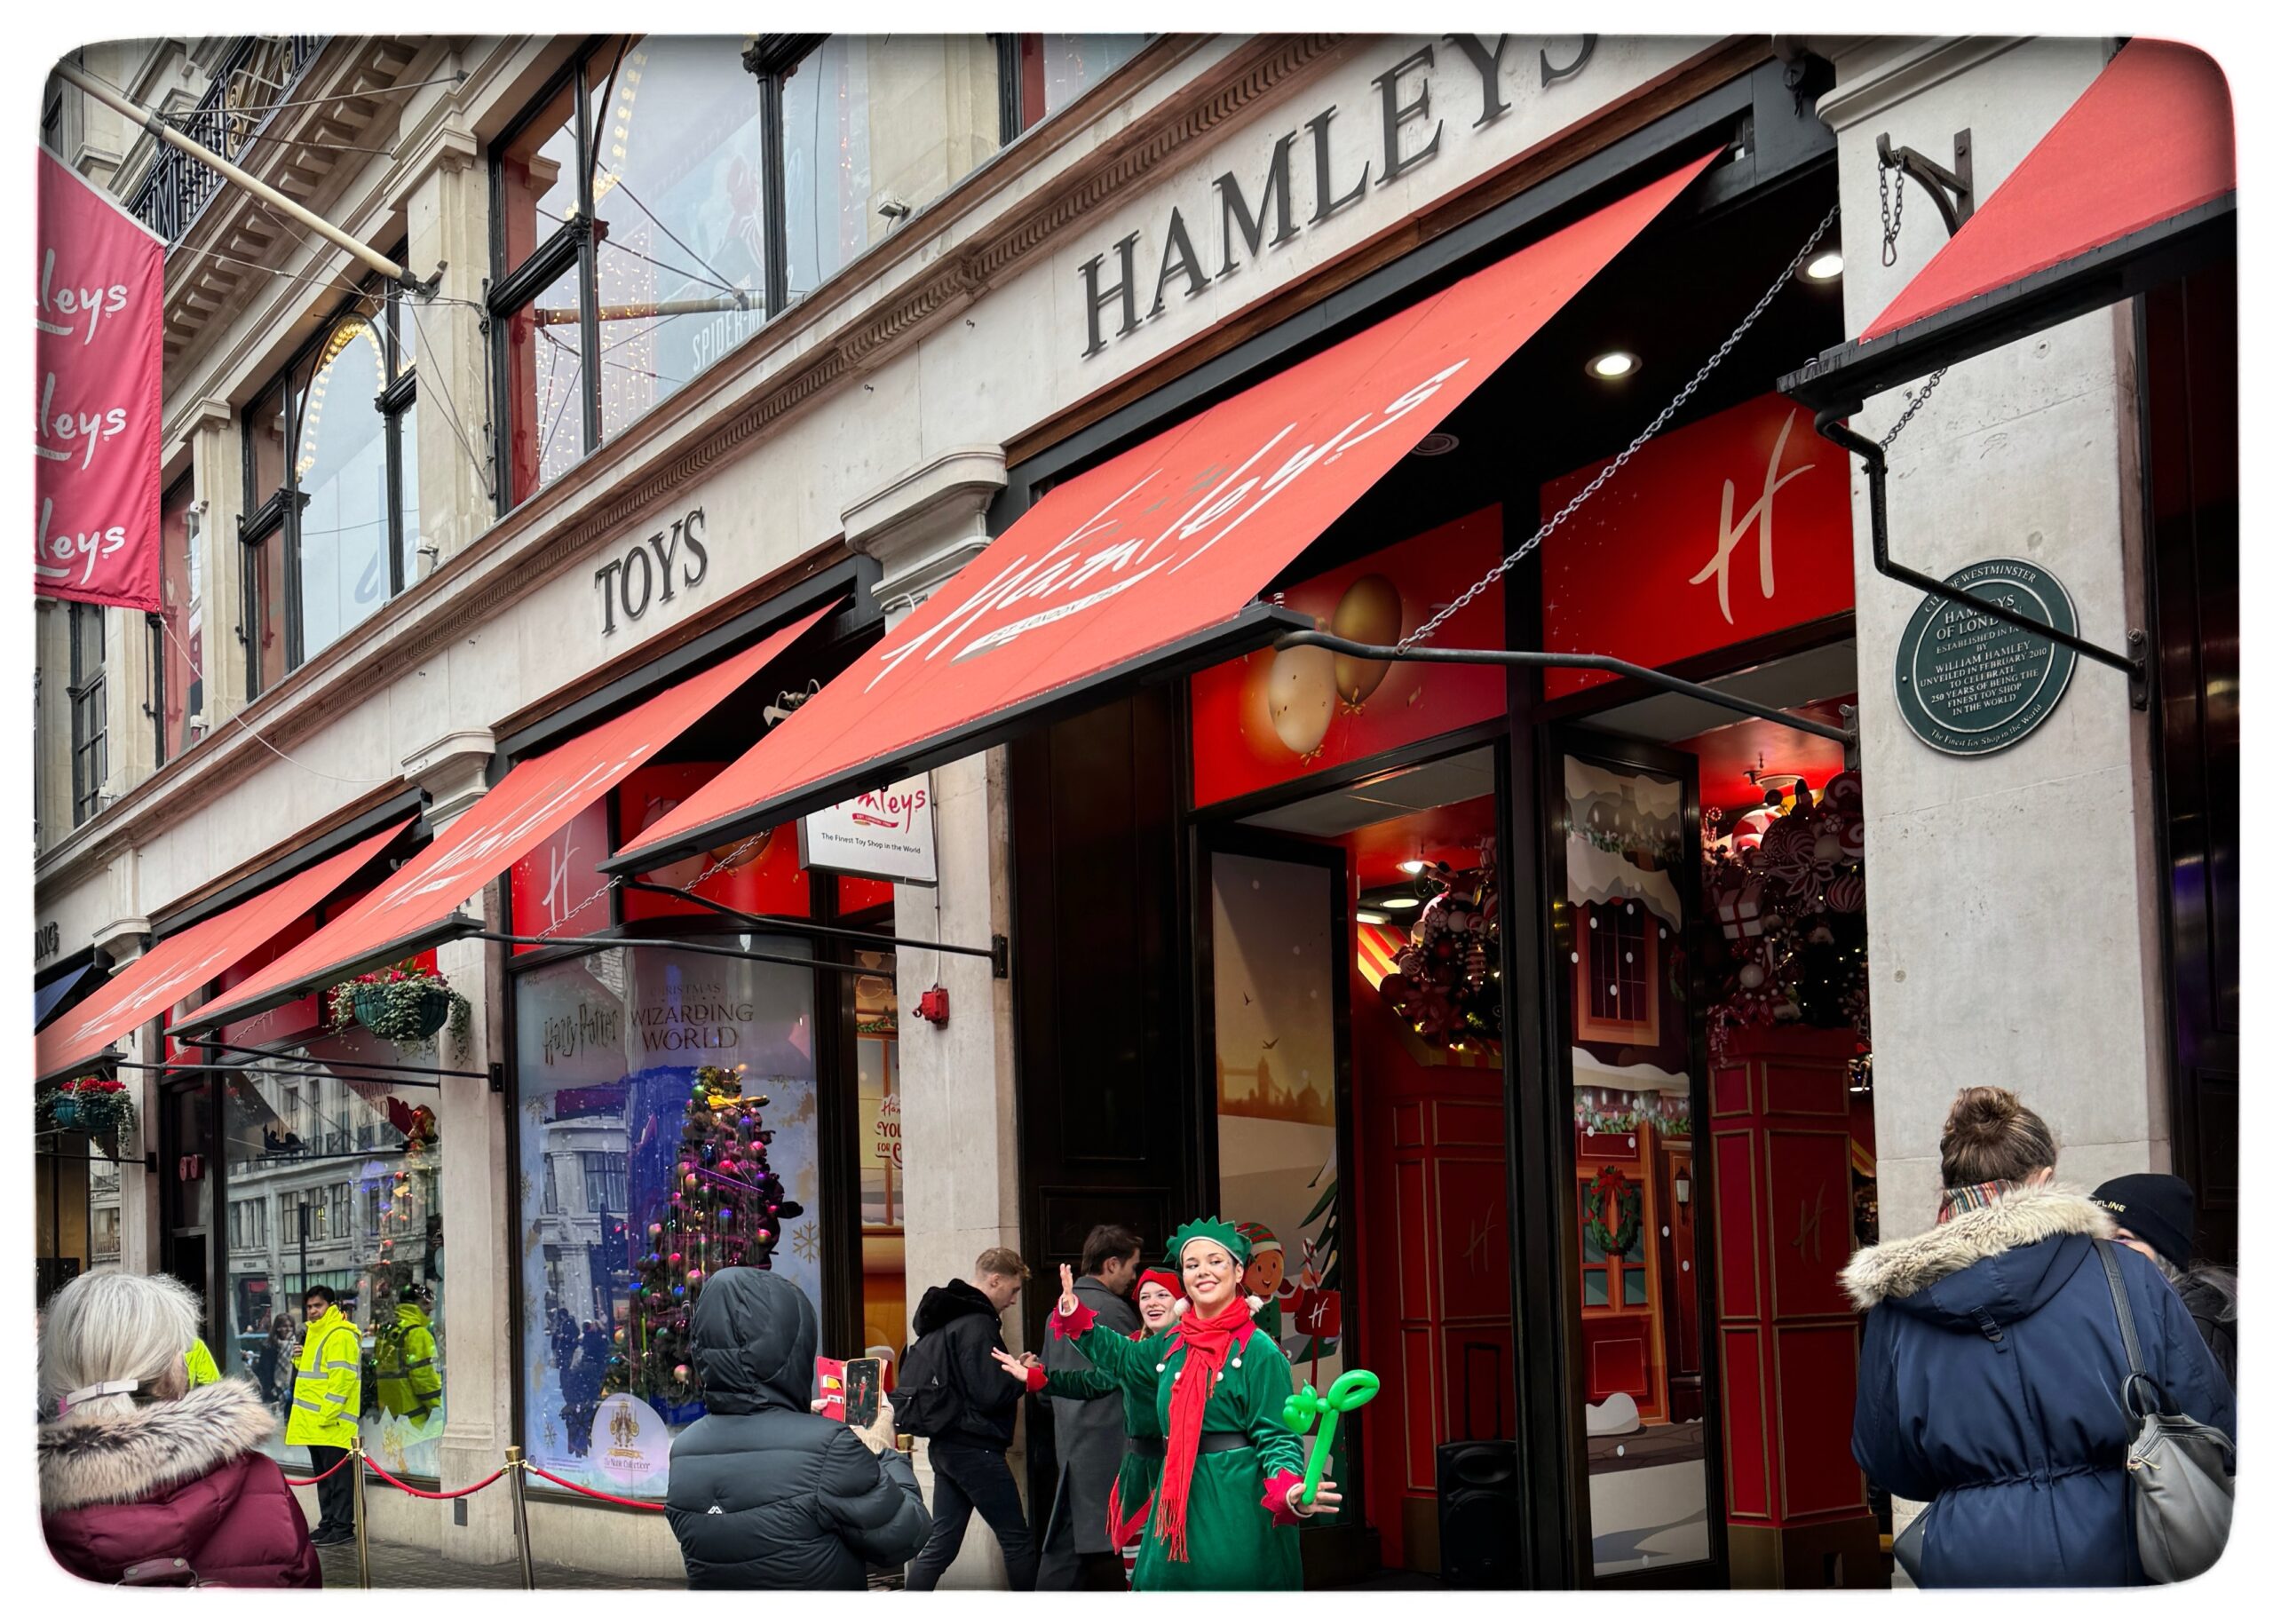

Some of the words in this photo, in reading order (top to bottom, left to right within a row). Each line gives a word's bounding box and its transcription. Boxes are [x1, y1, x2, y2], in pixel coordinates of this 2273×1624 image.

[36, 248, 128, 345] leys
[693, 289, 766, 373] SPIDER-M
[36, 372, 127, 471] leys
[36, 497, 126, 585] leys
[864, 358, 1470, 694] Hamleys
[594, 505, 708, 635] TOYS
[1960, 565, 2037, 583] WESTMINSTER
[1936, 625, 1956, 641] OF
[1959, 606, 2023, 635] LOND
[1944, 594, 2016, 625] HAMYS
[1936, 631, 1996, 654] ESTABLISHED
[1998, 627, 2008, 637] IN
[1936, 654, 1982, 674] WILLIAM
[1985, 640, 2031, 661] HAMLEY
[1976, 643, 1989, 653] BY
[1920, 669, 1966, 687] UNVEILED
[1968, 665, 1978, 675] IN
[1979, 653, 2028, 671] FEBRUARY
[2029, 647, 2047, 659] 2010
[1950, 680, 1962, 689] TO
[1963, 666, 2016, 685] CELEBRATE
[1931, 693, 1944, 703] 250
[1946, 685, 1975, 699] YEARS
[1976, 682, 1988, 692] OF
[1990, 675, 2018, 688] BEING
[2021, 669, 2039, 681] THE
[1947, 693, 1979, 709] FINEST
[1981, 688, 1998, 701] TOY
[1999, 683, 2023, 696] SHOP
[1952, 708, 1963, 717] IN
[1965, 704, 1982, 713] THE
[1984, 693, 2016, 708] WORLD
[1931, 729, 1944, 741] The
[1944, 735, 1965, 746] Finest
[1981, 735, 2000, 745] Shop
[2009, 724, 2022, 734] the
[2021, 704, 2042, 725] World
[823, 789, 927, 834] mleys
[821, 832, 834, 842] The
[835, 834, 854, 844] Finest
[855, 837, 867, 847] Toy
[867, 839, 883, 850] Shop
[902, 845, 921, 854] World
[35, 921, 60, 962] NG
[630, 1003, 754, 1027] WIZARDING
[543, 1016, 577, 1066] Harry
[578, 1002, 619, 1065] Potter
[641, 1026, 739, 1051] WORLD
